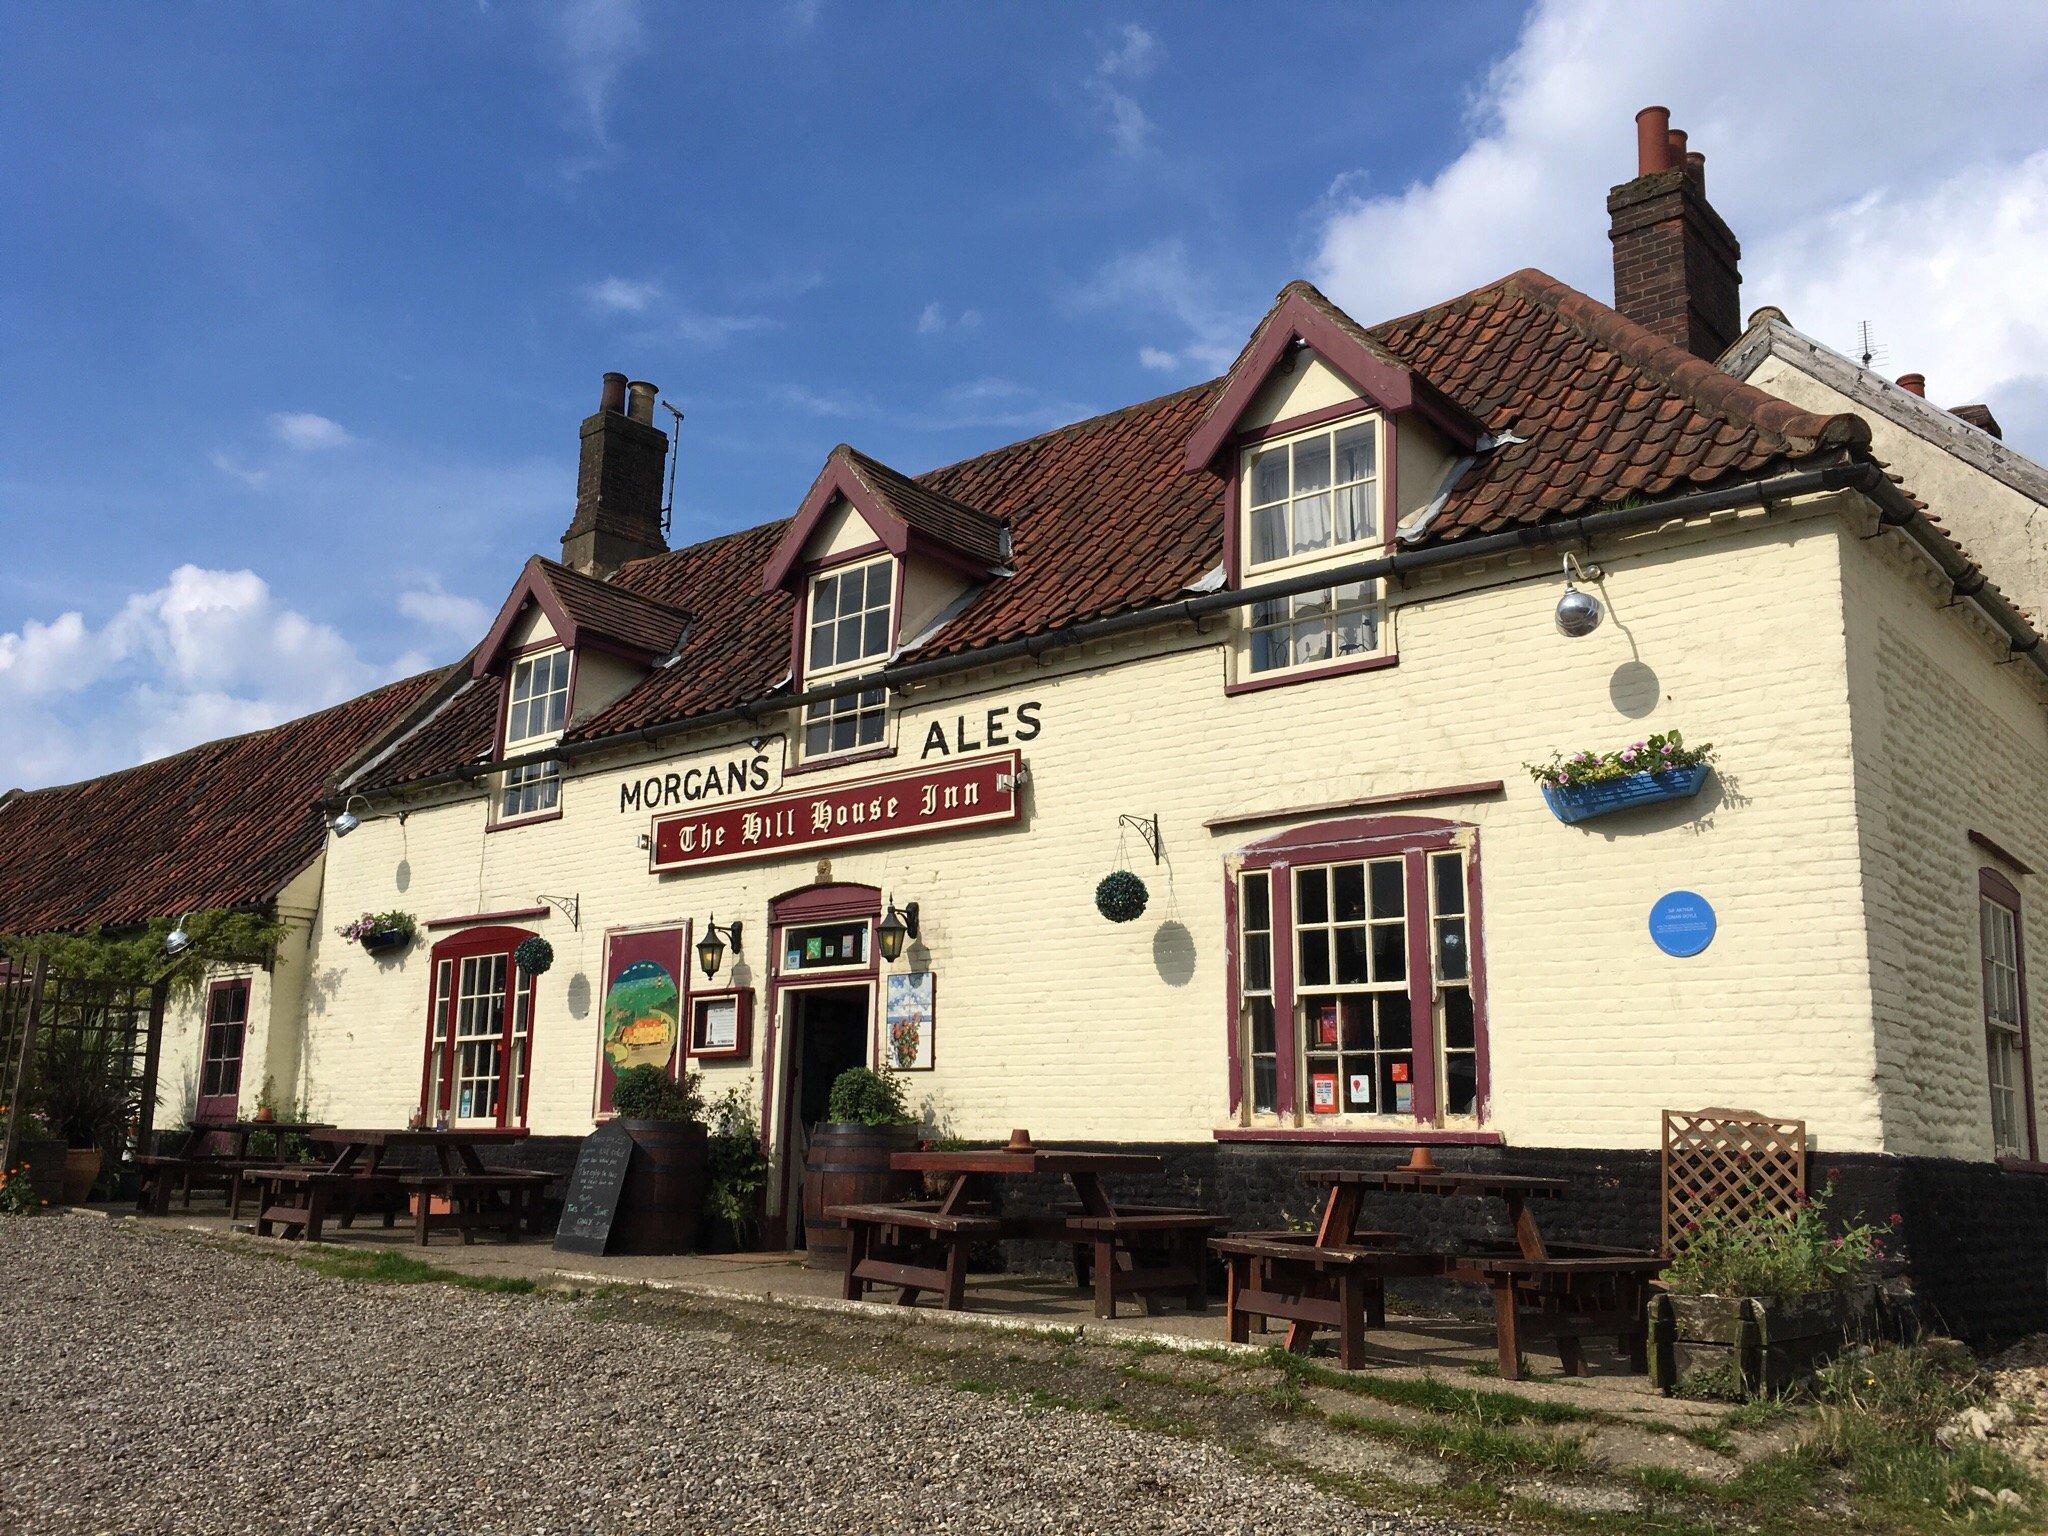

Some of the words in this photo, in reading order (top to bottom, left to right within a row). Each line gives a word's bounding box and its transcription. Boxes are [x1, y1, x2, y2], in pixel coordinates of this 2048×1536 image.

[620, 755, 770, 813] MORGANS
[920, 701, 1042, 760] ALES
[679, 822, 726, 853] The
[741, 808, 795, 845] Hill
[811, 796, 899, 835] House
[919, 782, 979, 816] Inn
